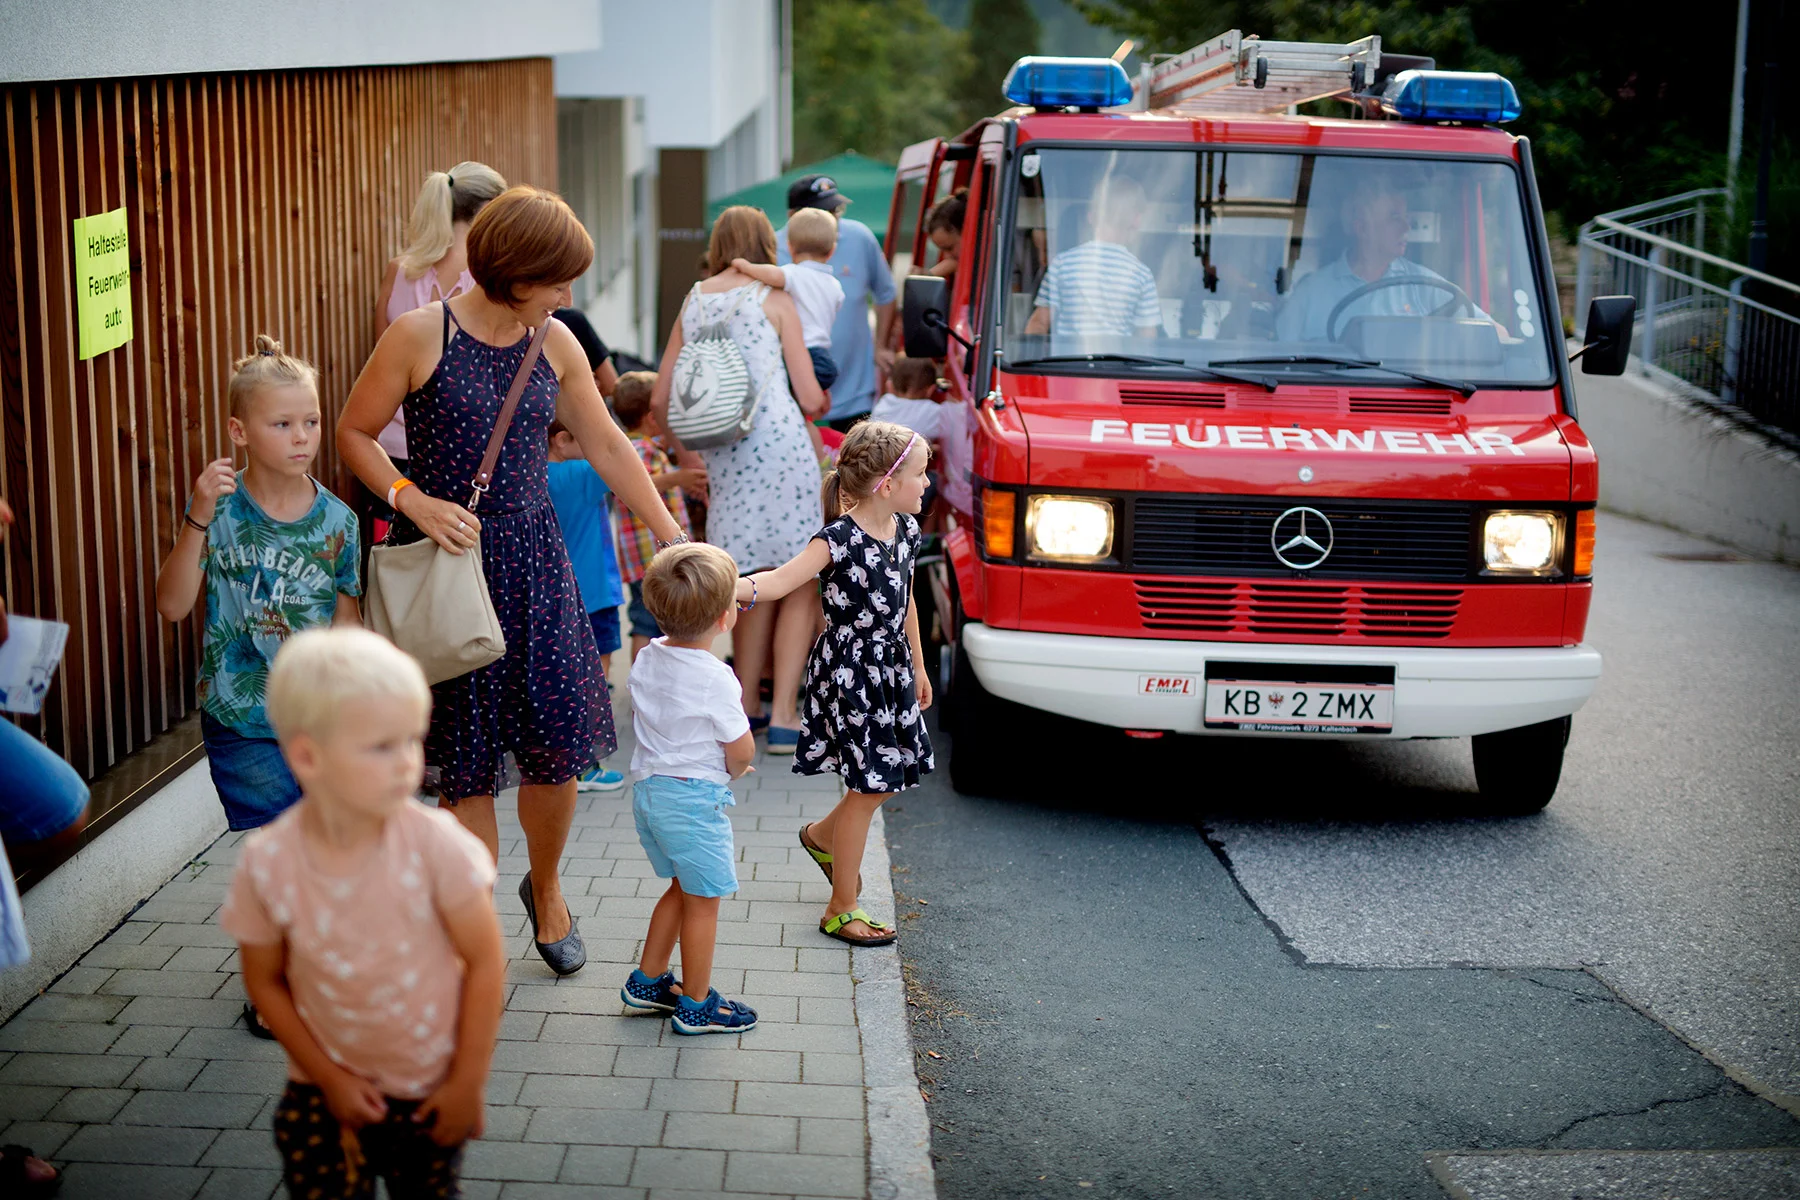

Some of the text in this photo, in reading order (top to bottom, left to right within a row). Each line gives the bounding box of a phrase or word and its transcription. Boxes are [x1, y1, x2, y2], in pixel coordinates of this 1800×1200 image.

[88, 229, 127, 258] Haltestelle
[105, 307, 122, 329] auto
[1090, 419, 1526, 456] FEUERWEHR
[217, 544, 331, 591] CALI BEACH
[244, 609, 270, 621] BEACH
[1145, 678, 1189, 693] EMPL
[1224, 689, 1376, 719] KB 2 ZMX
[1257, 724, 1300, 732] Fahrzeugwerk
